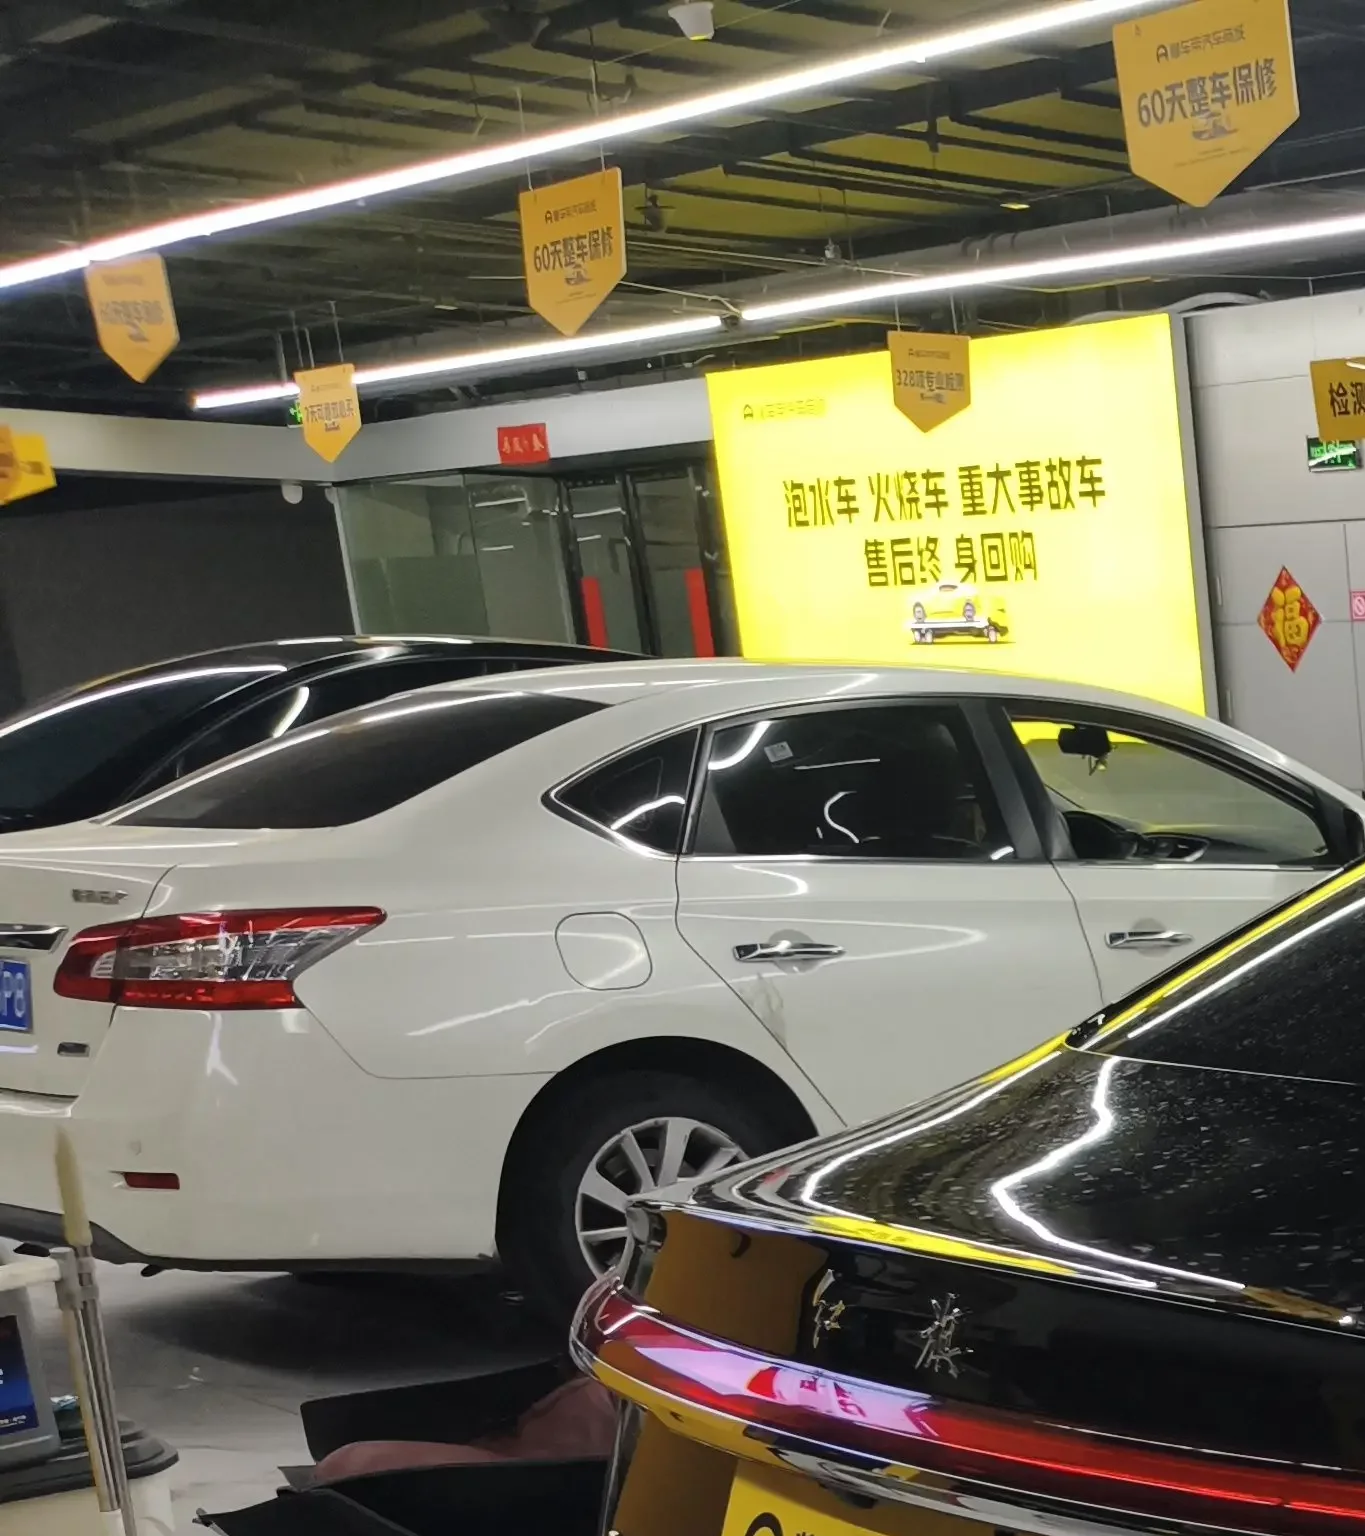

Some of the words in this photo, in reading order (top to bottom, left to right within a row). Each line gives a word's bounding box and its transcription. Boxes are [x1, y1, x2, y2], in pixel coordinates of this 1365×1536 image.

[1137, 57, 1278, 128] 60天整车保修
[783, 475, 860, 528] 泡水车
[868, 468, 949, 523] 火烧车
[957, 455, 1106, 517] 重大事故车
[1271, 586, 1310, 648] 福
